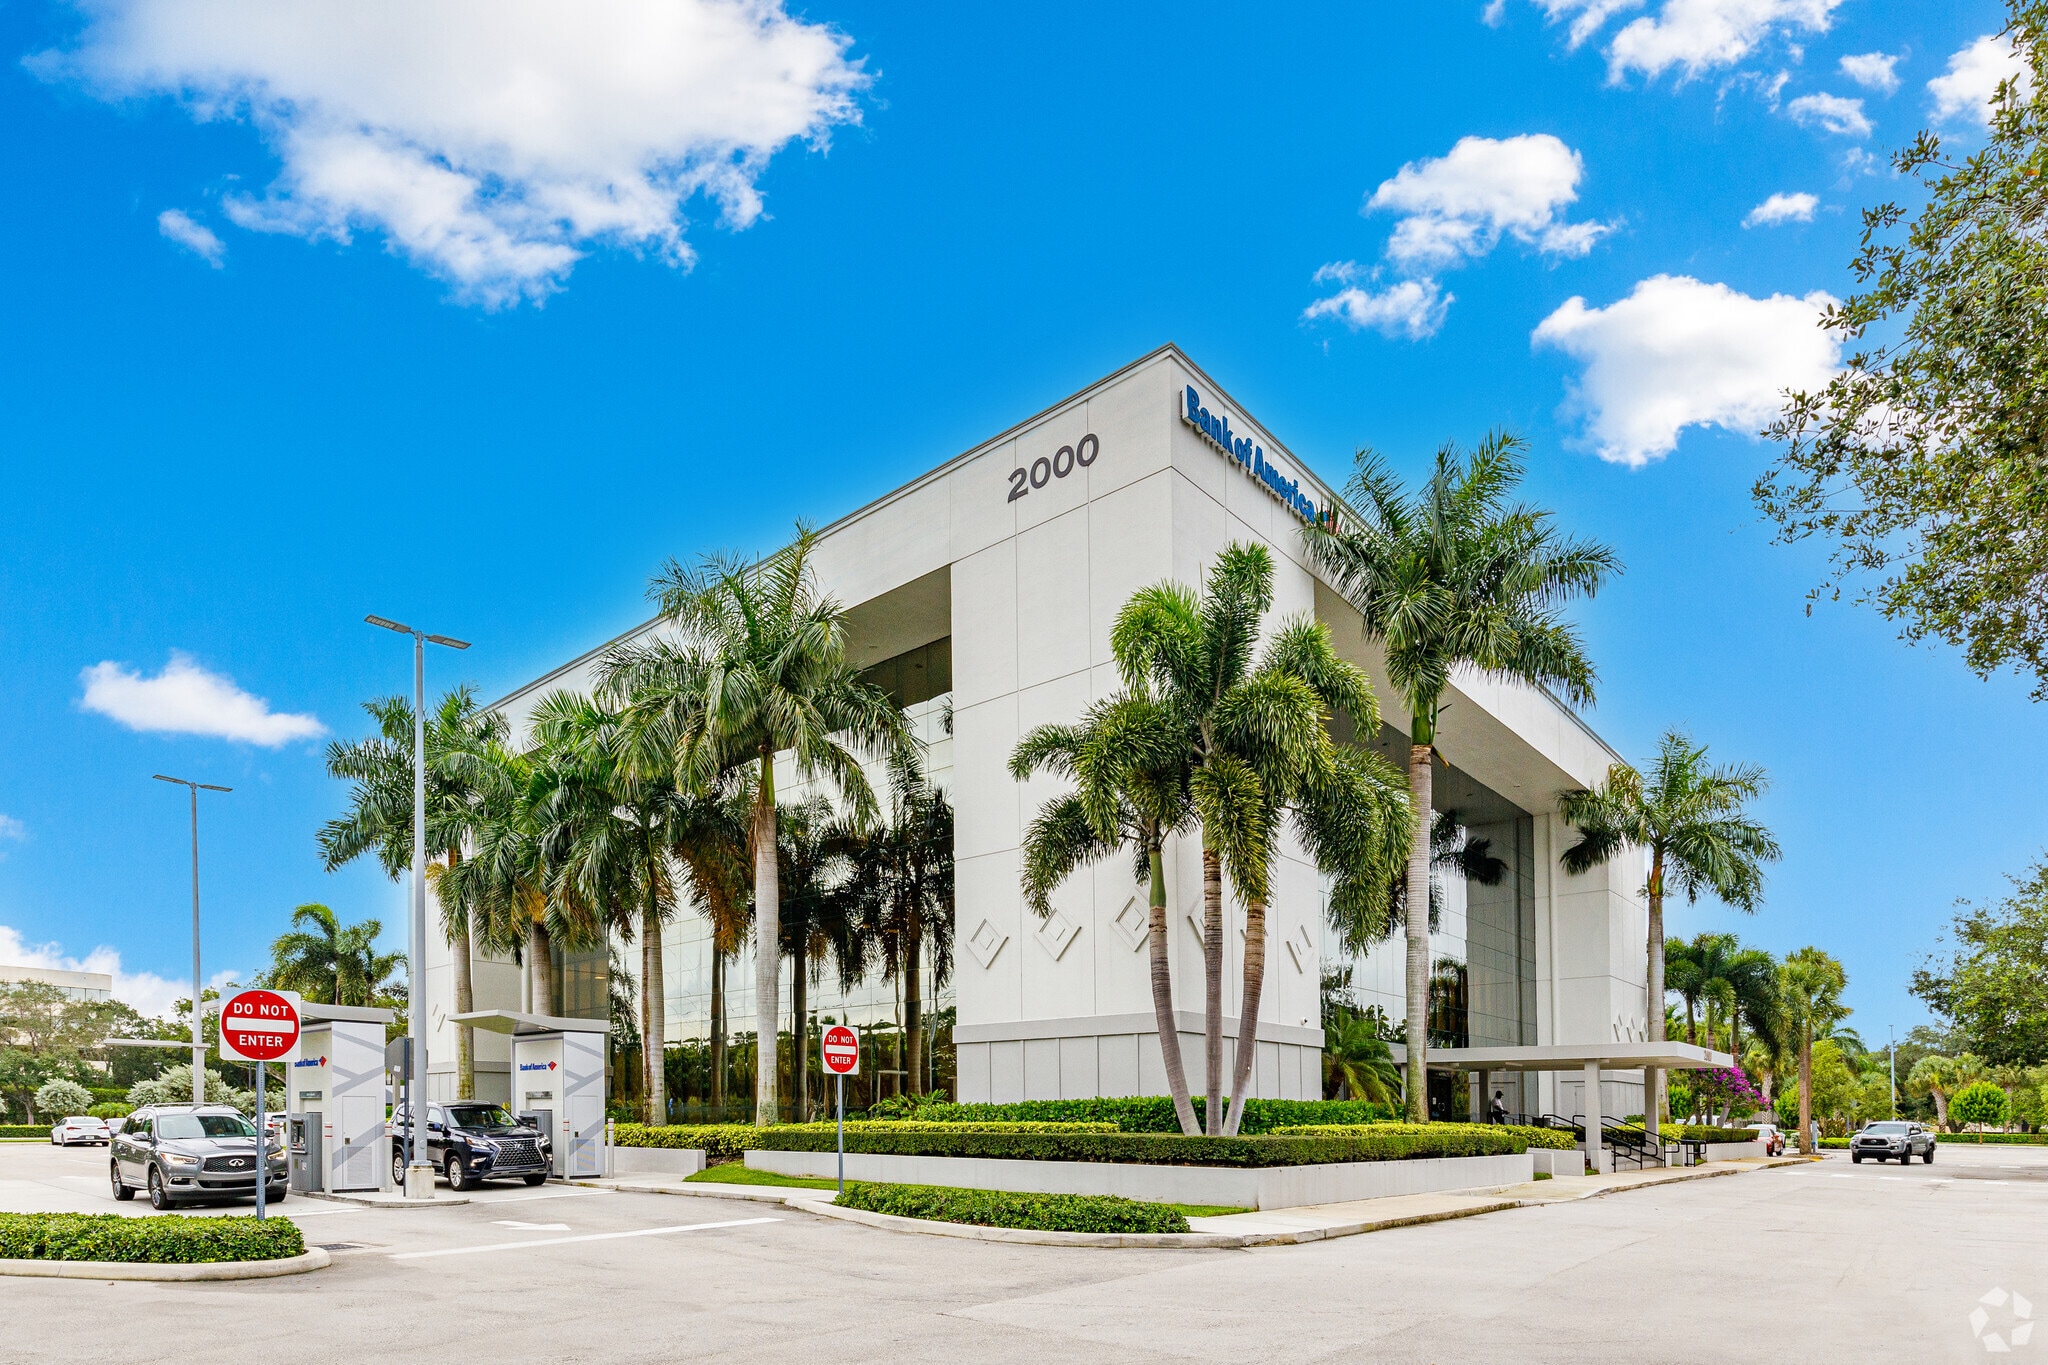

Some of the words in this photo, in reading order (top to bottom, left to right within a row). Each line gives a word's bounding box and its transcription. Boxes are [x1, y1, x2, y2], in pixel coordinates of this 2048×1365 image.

[1187, 385, 1233, 454] Bank
[1234, 437, 1252, 468] of
[1253, 445, 1315, 523] America
[1008, 433, 1099, 503] 2000
[234, 1002, 253, 1014] DO
[260, 1004, 288, 1016] NOT
[239, 1034, 282, 1047] ENTER
[828, 1035, 838, 1043] DO
[841, 1036, 853, 1044] NOT
[831, 1056, 851, 1064] ENTER
